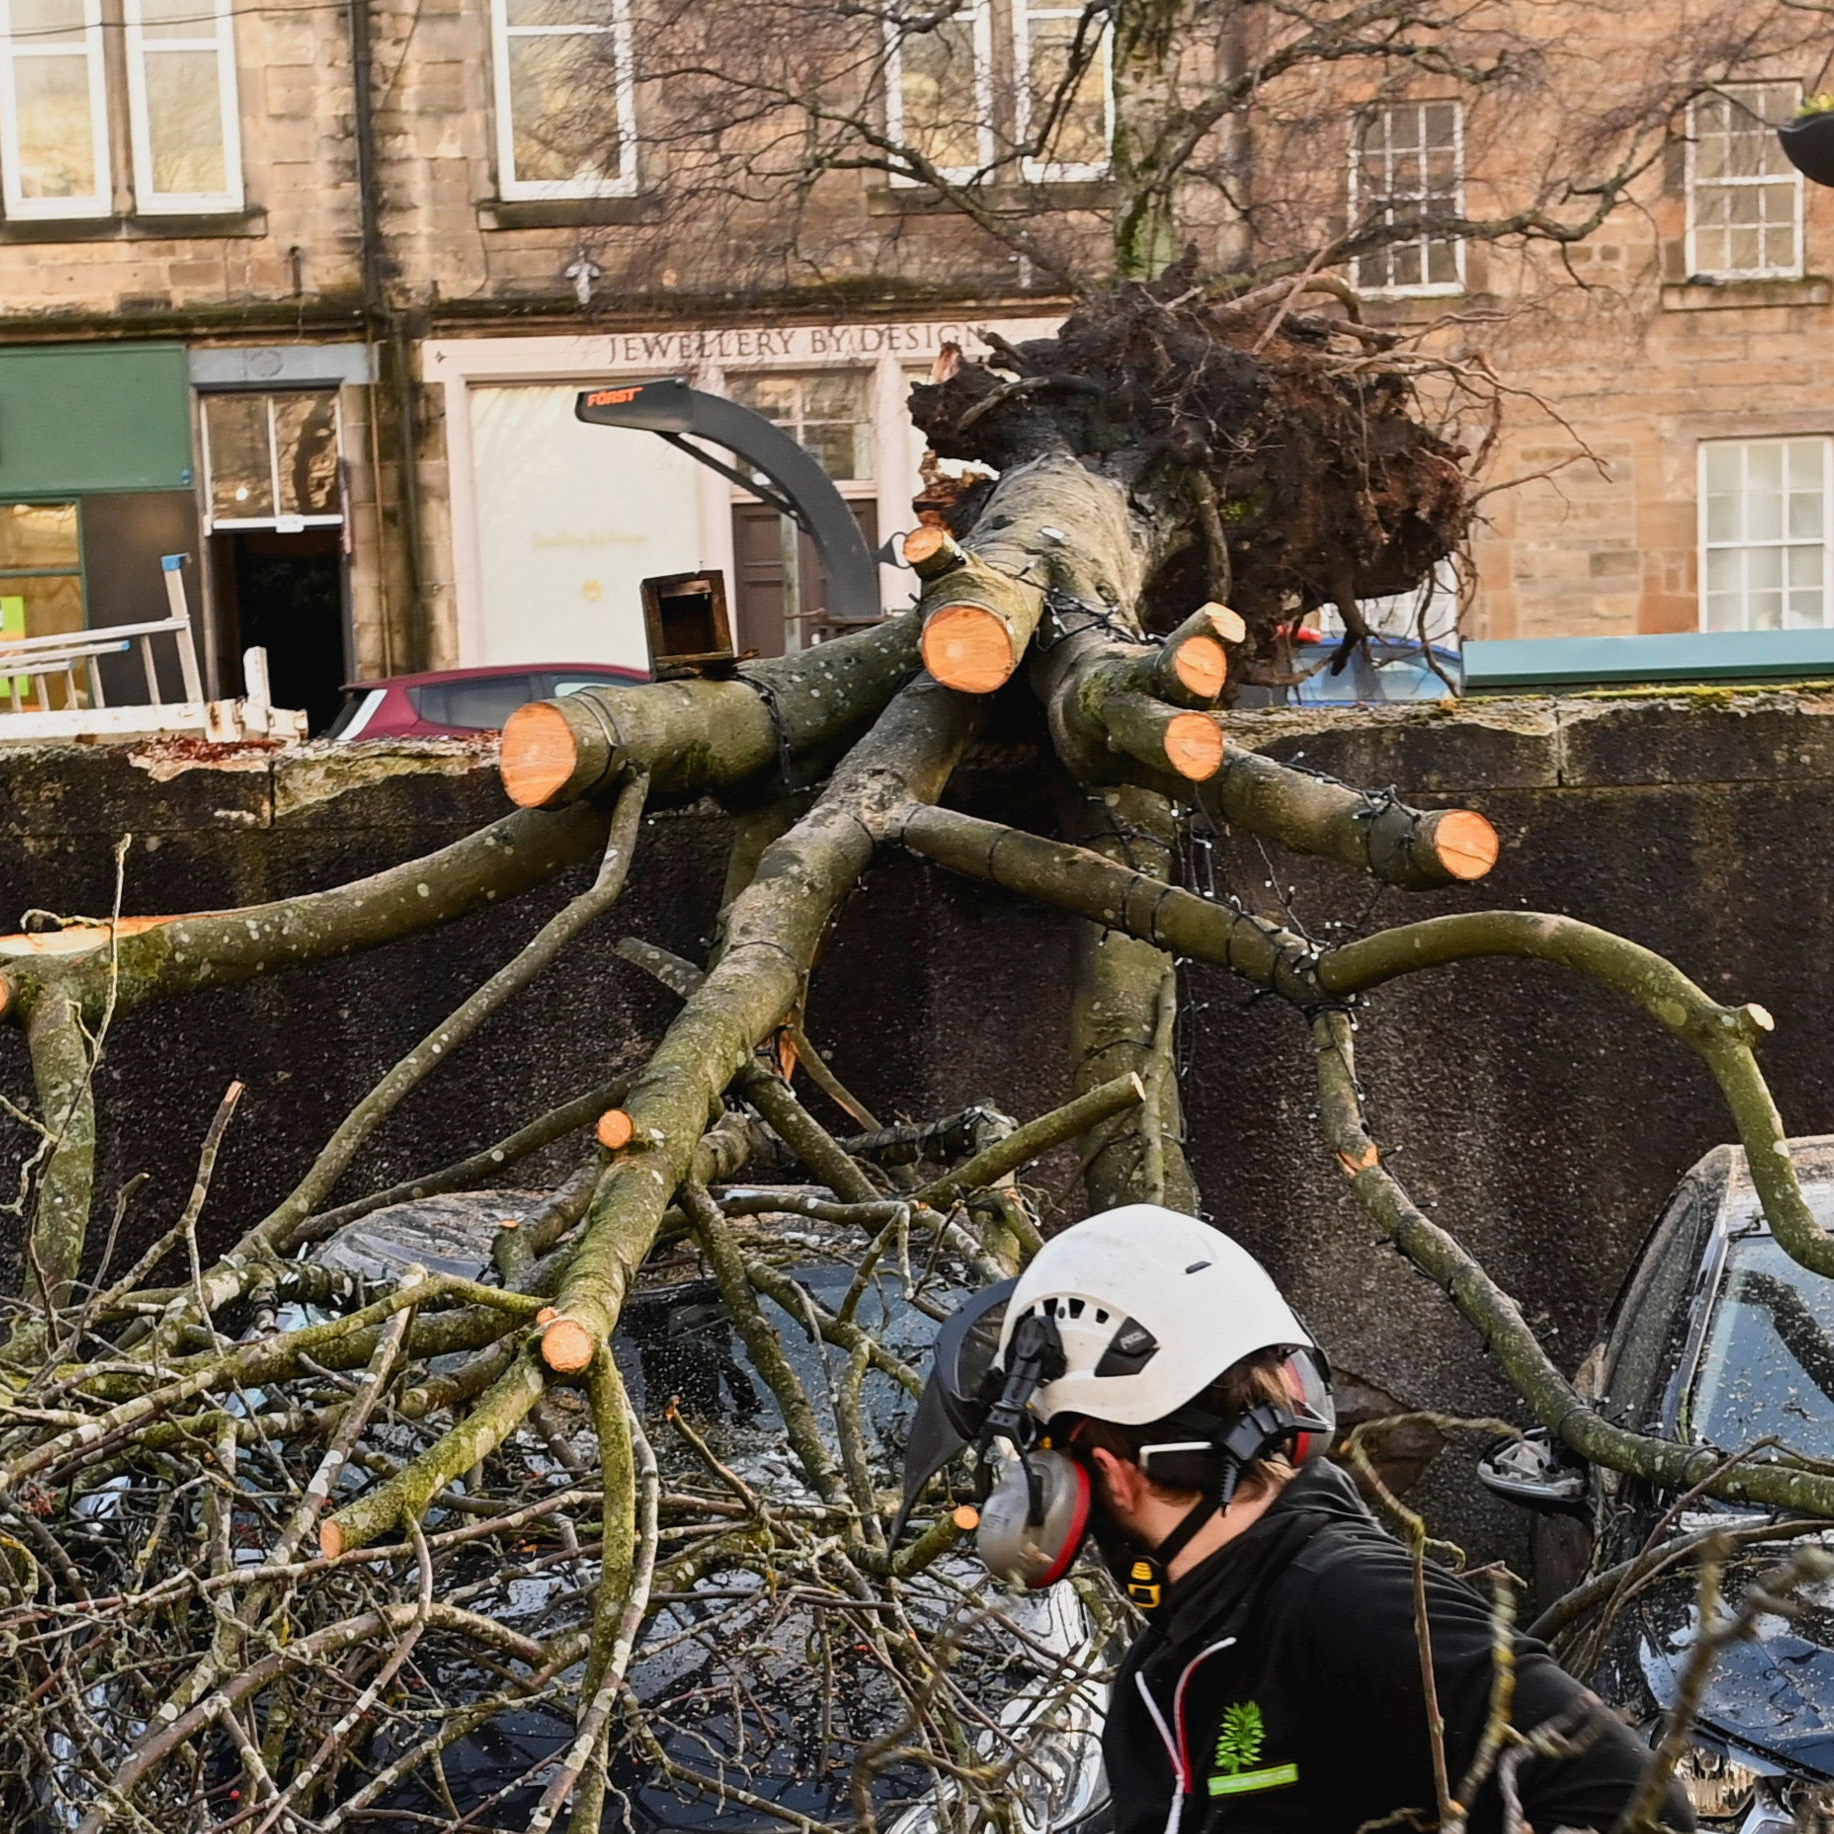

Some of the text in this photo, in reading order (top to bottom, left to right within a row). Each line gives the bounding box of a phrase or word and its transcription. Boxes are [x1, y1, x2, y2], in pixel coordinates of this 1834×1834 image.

[608, 322, 989, 364] JEWELLERY BY DESIGN
